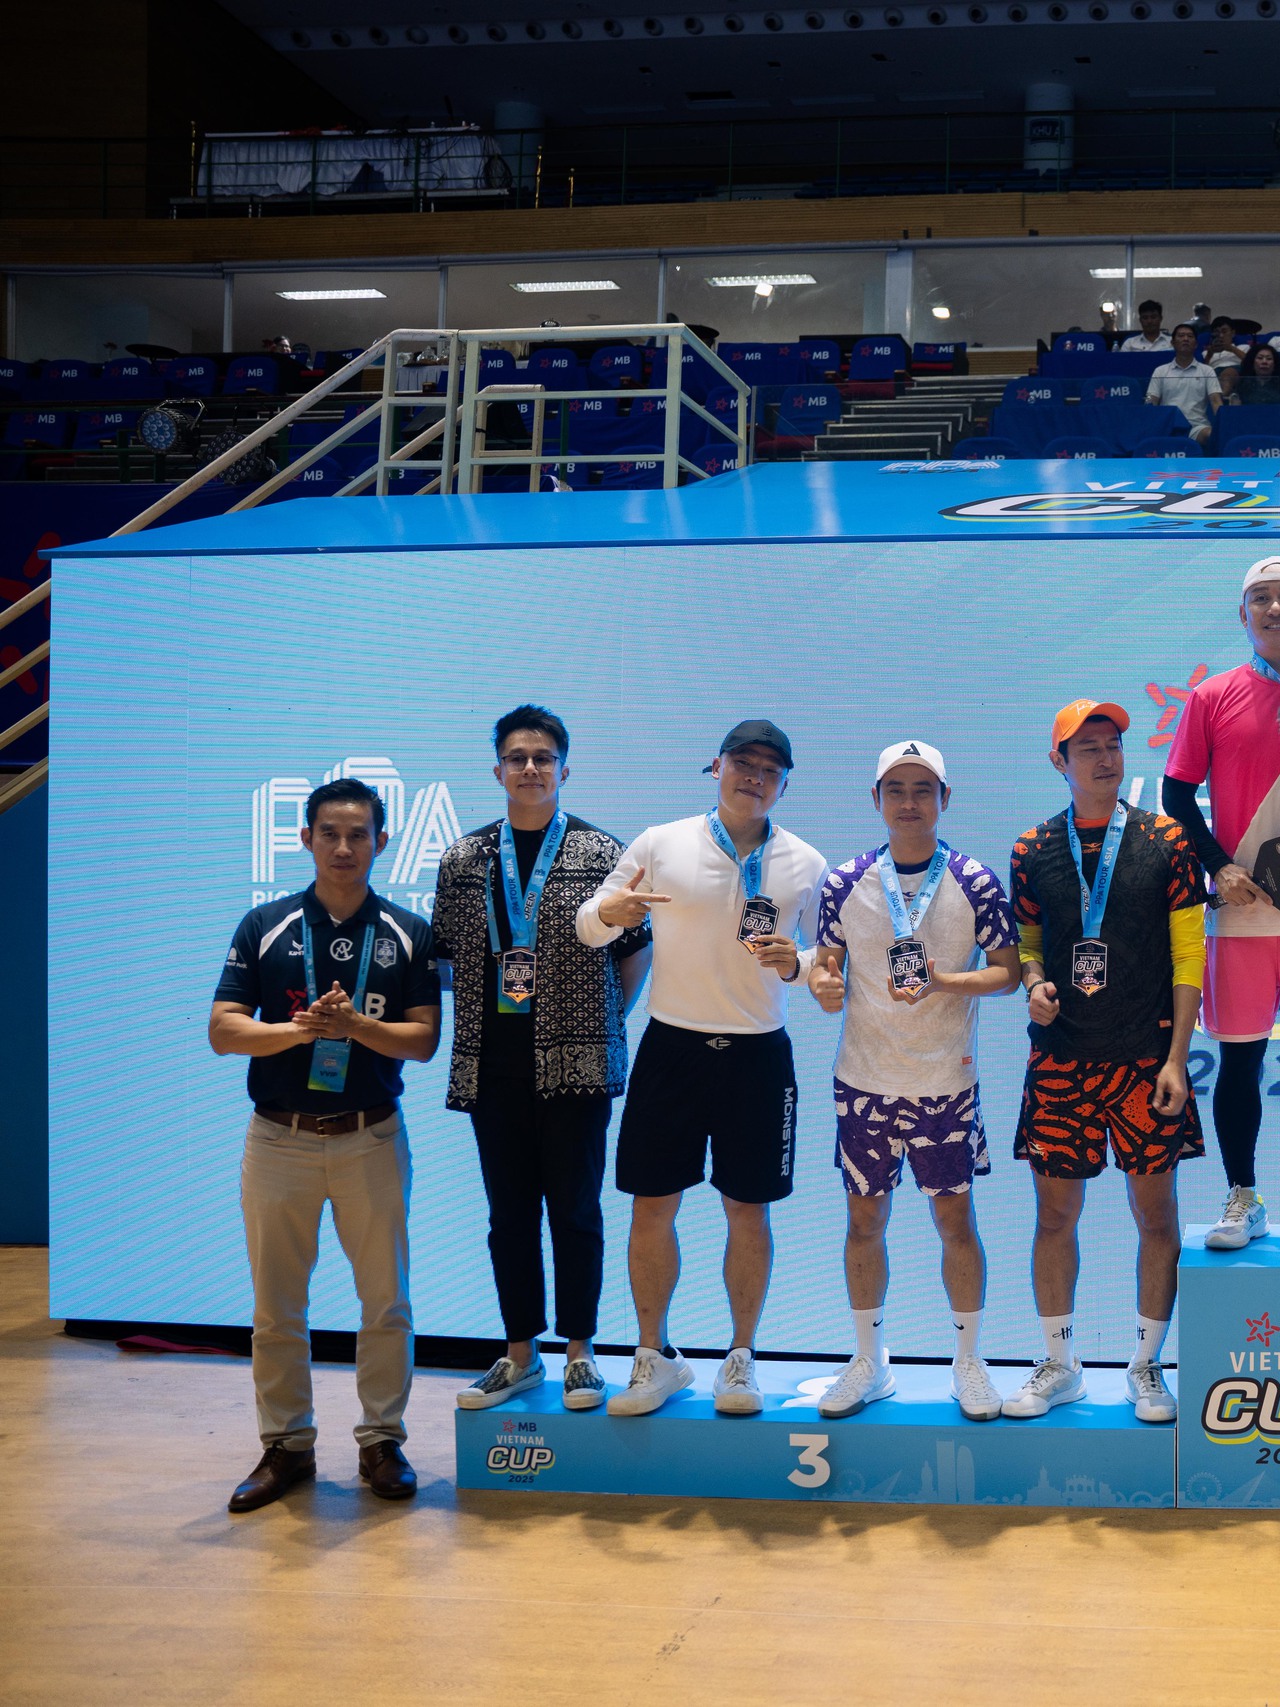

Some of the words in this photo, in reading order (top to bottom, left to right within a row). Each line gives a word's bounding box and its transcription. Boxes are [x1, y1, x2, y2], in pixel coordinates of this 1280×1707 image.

[873, 346, 891, 356] MB
[1078, 342, 1096, 352] MB
[613, 355, 631, 365] MB
[812, 351, 830, 360] MB
[487, 359, 504, 368] MB
[551, 359, 568, 368] MB
[61, 369, 78, 378] MB
[122, 367, 139, 376] MB
[188, 366, 205, 376] MB
[247, 368, 264, 377] MB
[1110, 386, 1130, 396] MB
[584, 401, 602, 411] MB
[808, 396, 827, 407] MB
[37, 414, 56, 424] MB
[104, 413, 123, 423] MB
[1258, 448, 1280, 459] MB
[635, 460, 656, 471] MB
[303, 470, 324, 481] MB
[549, 824, 562, 843] TOUR
[1105, 846, 1114, 866] ASIA
[506, 858, 515, 879] ASIA
[1098, 867, 1109, 888] TOUR
[508, 879, 518, 899] TOUR
[1095, 888, 1104, 904] PPA
[744, 917, 773, 930] CUP
[894, 959, 924, 976] CUP
[1075, 961, 1104, 973] CUP
[506, 969, 534, 980] CUP
[780, 1086, 794, 1177] MONSTER
[518, 1422, 537, 1432] MB
[496, 1435, 545, 1446] VIETNAM
[487, 1446, 555, 1473] CUP
[787, 1433, 831, 1489] 3
[508, 1475, 534, 1483] 2025
